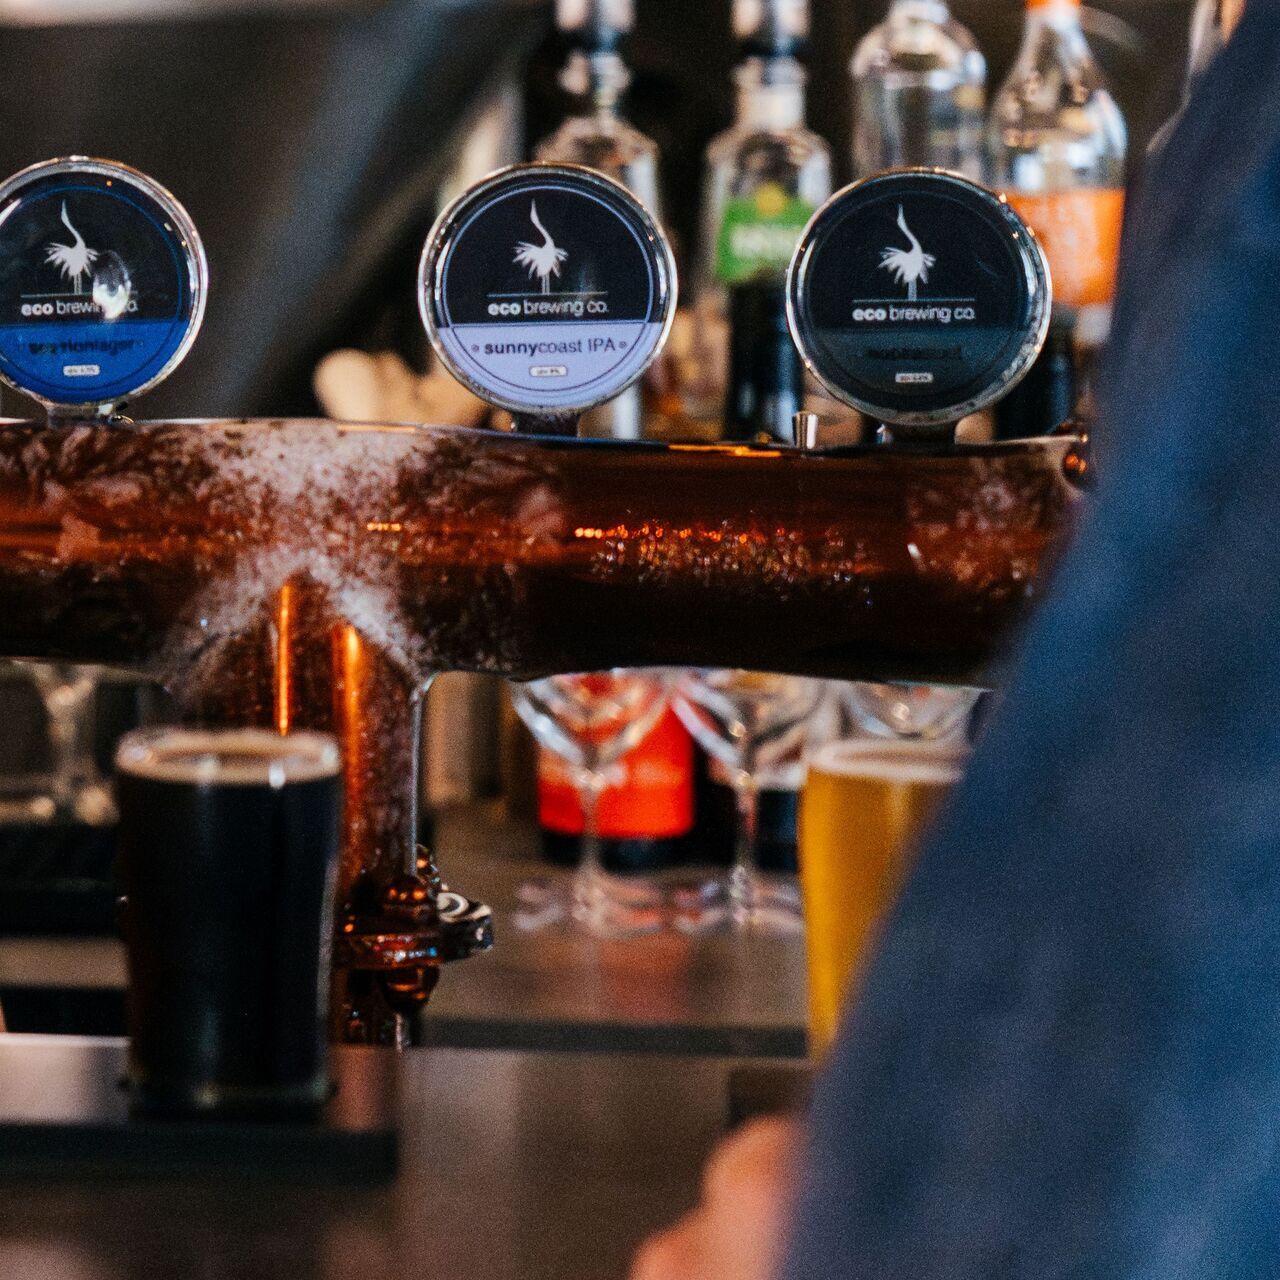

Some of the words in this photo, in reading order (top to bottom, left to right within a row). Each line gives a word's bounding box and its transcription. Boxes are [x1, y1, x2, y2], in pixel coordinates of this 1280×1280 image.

[21, 303, 54, 316] eco
[56, 300, 104, 314] brewin
[487, 302, 521, 316] eco
[523, 299, 584, 317] brewing
[852, 308, 887, 321] eco
[889, 305, 952, 323] brewing
[484, 340, 582, 357] sunnycoast
[588, 337, 616, 352] IPA
